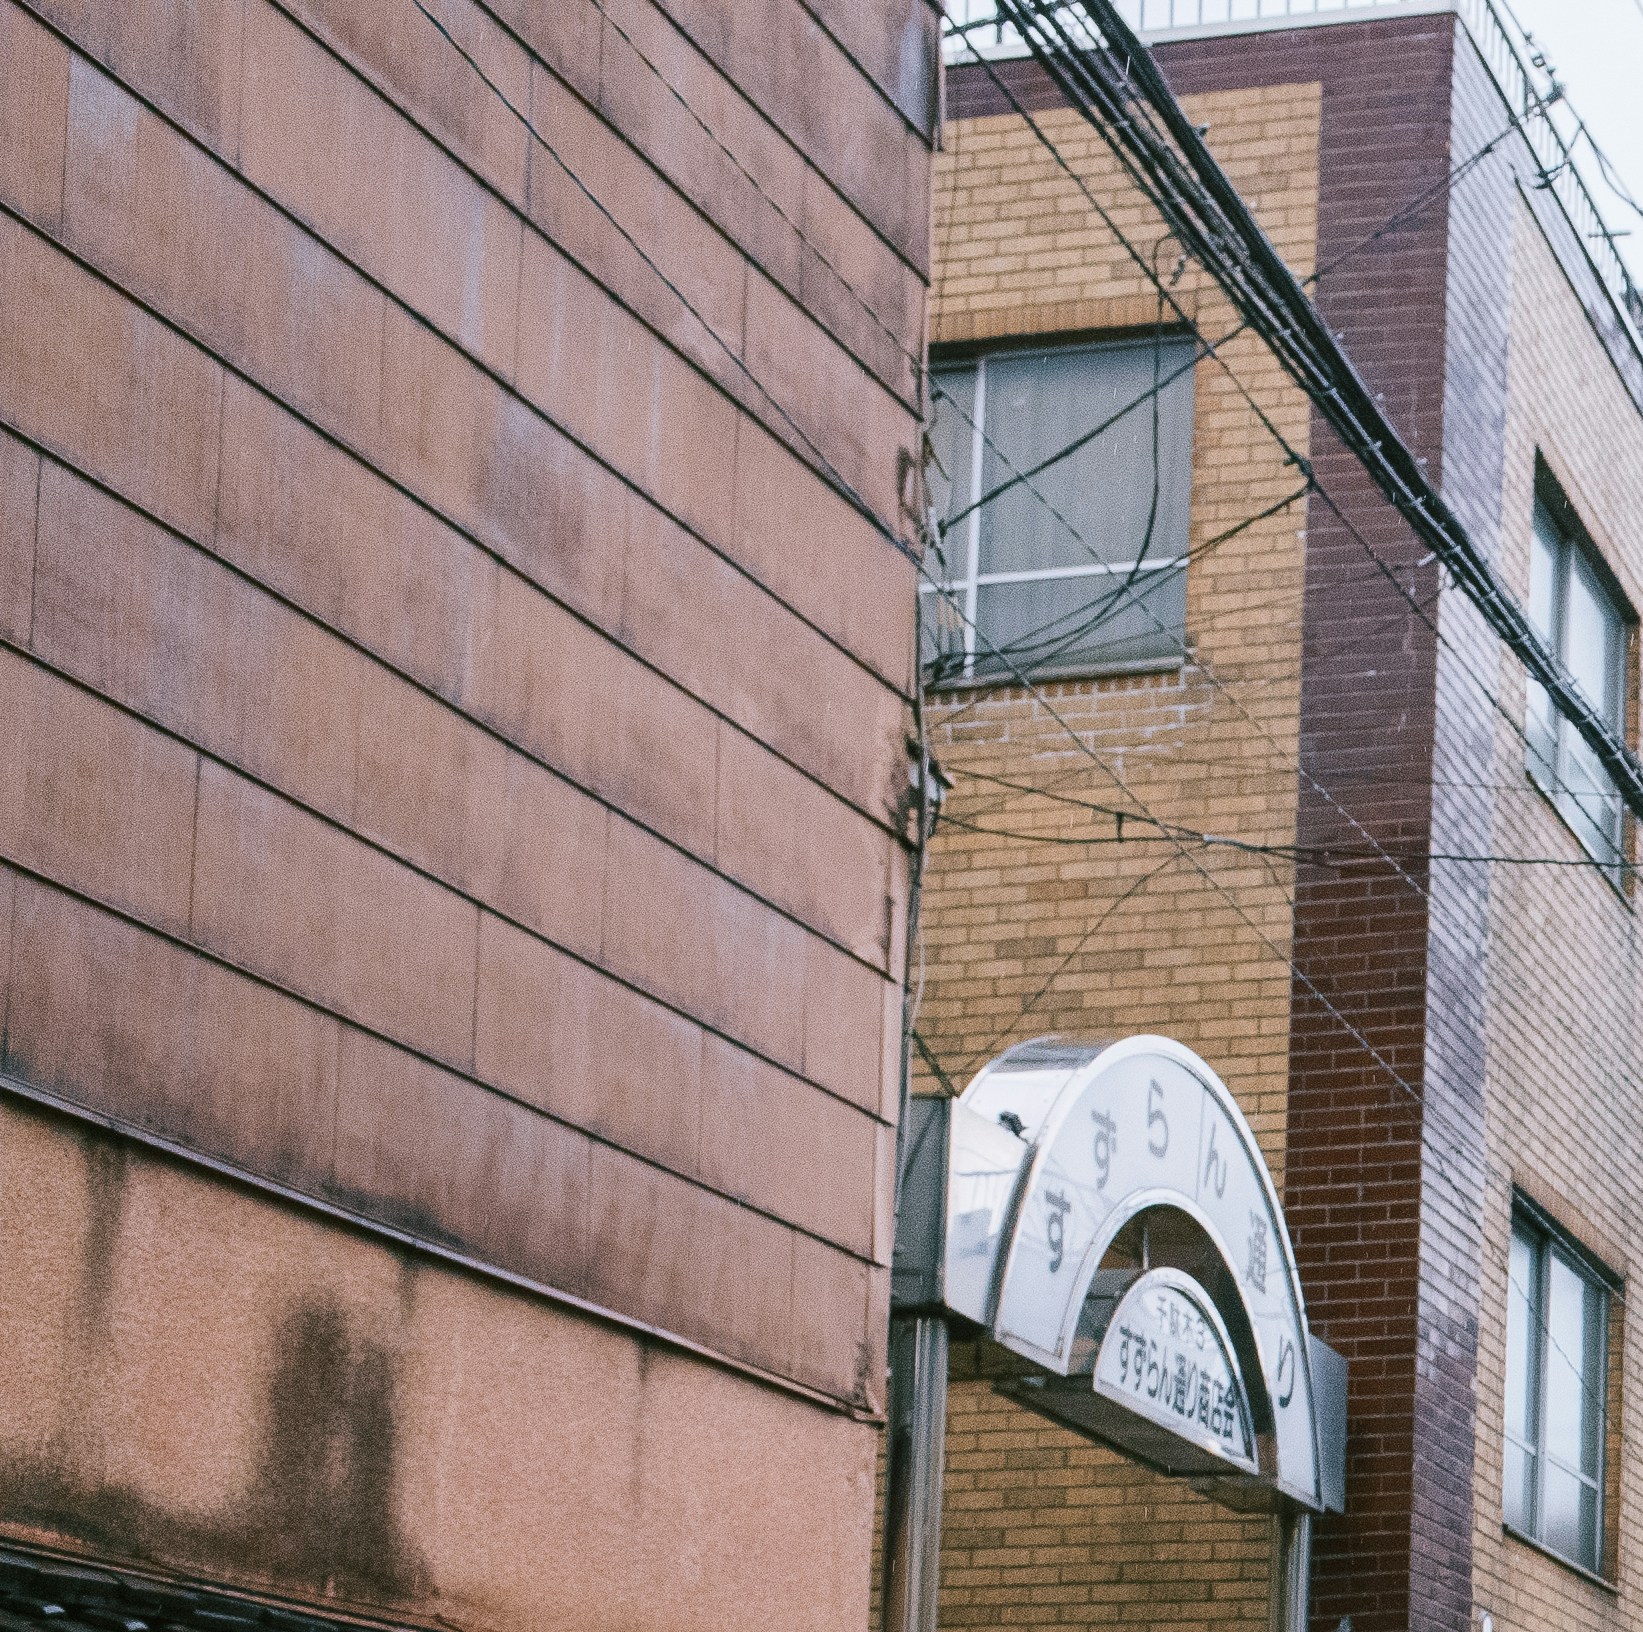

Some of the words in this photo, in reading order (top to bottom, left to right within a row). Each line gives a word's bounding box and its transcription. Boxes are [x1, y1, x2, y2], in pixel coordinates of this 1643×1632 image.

[1043, 1078, 1297, 1409] すずらん通り
